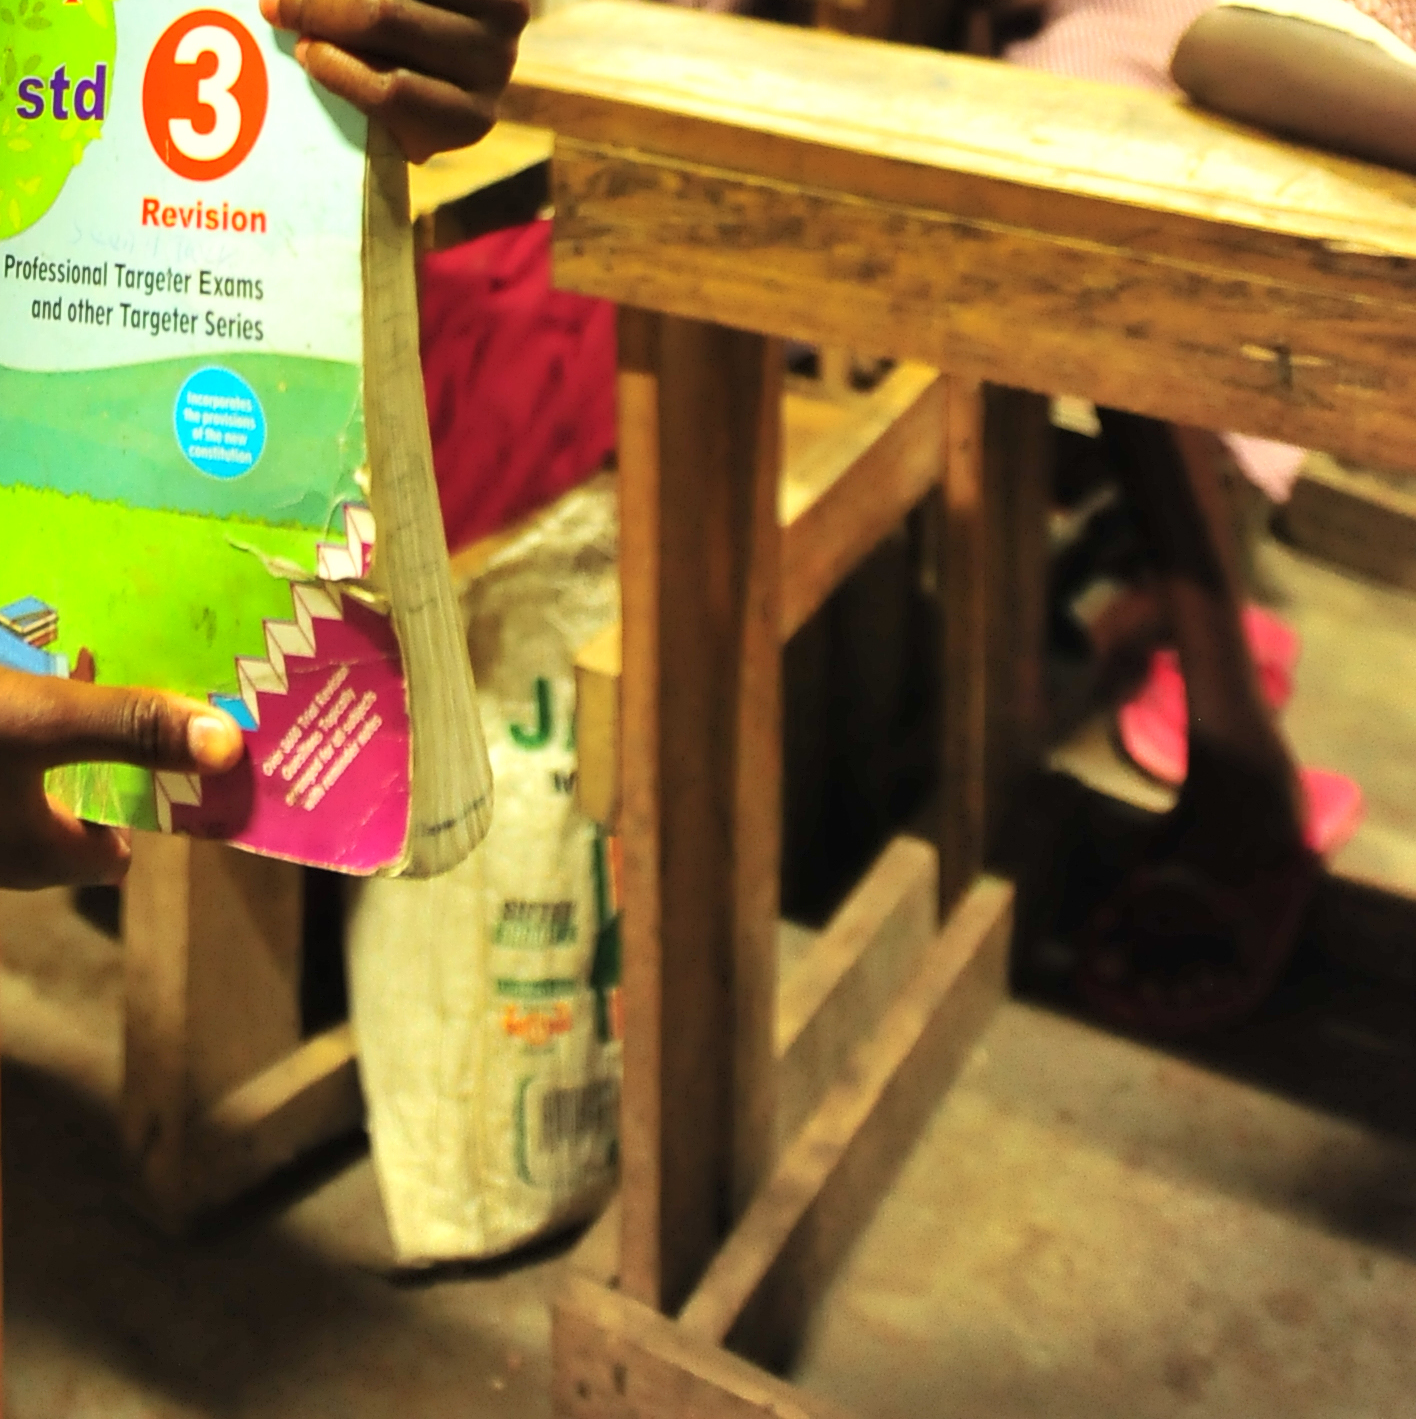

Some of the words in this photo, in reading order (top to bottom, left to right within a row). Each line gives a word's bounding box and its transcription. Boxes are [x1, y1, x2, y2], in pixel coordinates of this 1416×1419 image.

[16, 64, 107, 121] std
[168, 26, 243, 162] 3
[142, 198, 267, 233] Revision
[4, 254, 108, 287] Professional
[115, 263, 192, 295] Targeter
[199, 269, 265, 301] Exams
[31, 297, 62, 322] and
[67, 298, 114, 326] other
[120, 302, 199, 336] Targeter
[205, 310, 265, 341] Series
[188, 445, 252, 465] constitution
